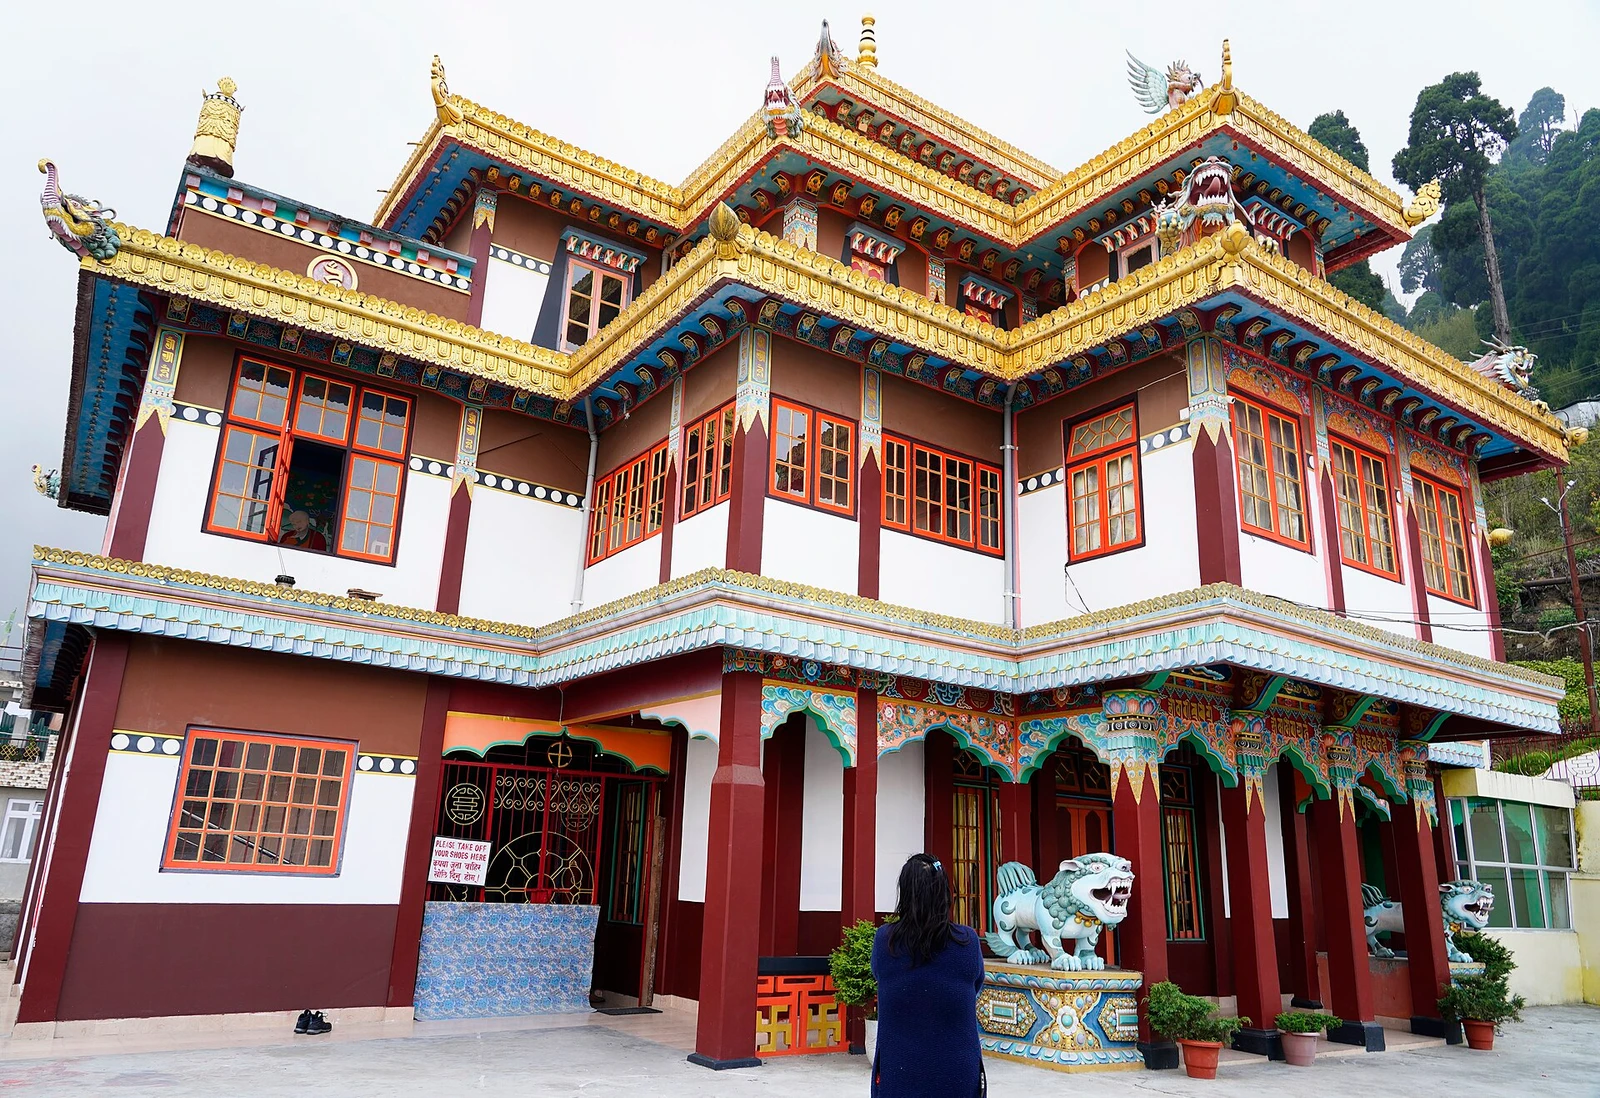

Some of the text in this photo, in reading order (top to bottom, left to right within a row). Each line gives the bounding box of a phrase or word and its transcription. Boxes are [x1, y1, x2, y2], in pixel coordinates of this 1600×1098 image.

[436, 840, 487, 852] PLEASE TAKE OFF
[435, 849, 486, 861] YOUR SHOES HERE
